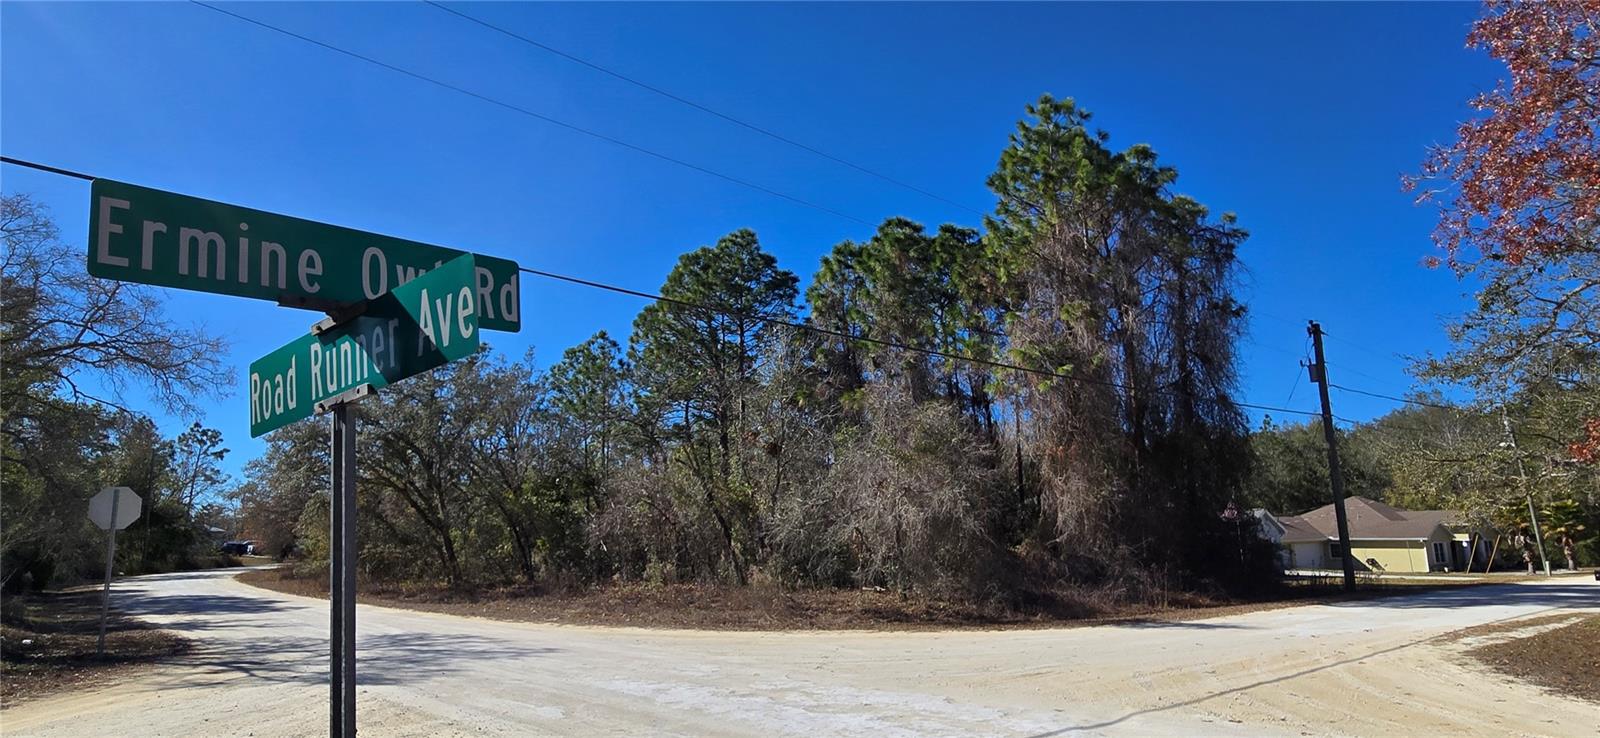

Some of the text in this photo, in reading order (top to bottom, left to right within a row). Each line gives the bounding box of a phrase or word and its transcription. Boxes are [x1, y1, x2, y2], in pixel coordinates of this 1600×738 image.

[97, 196, 323, 293] Ermine
[475, 266, 518, 322] Rd
[251, 286, 474, 425] Road Runner Ave
